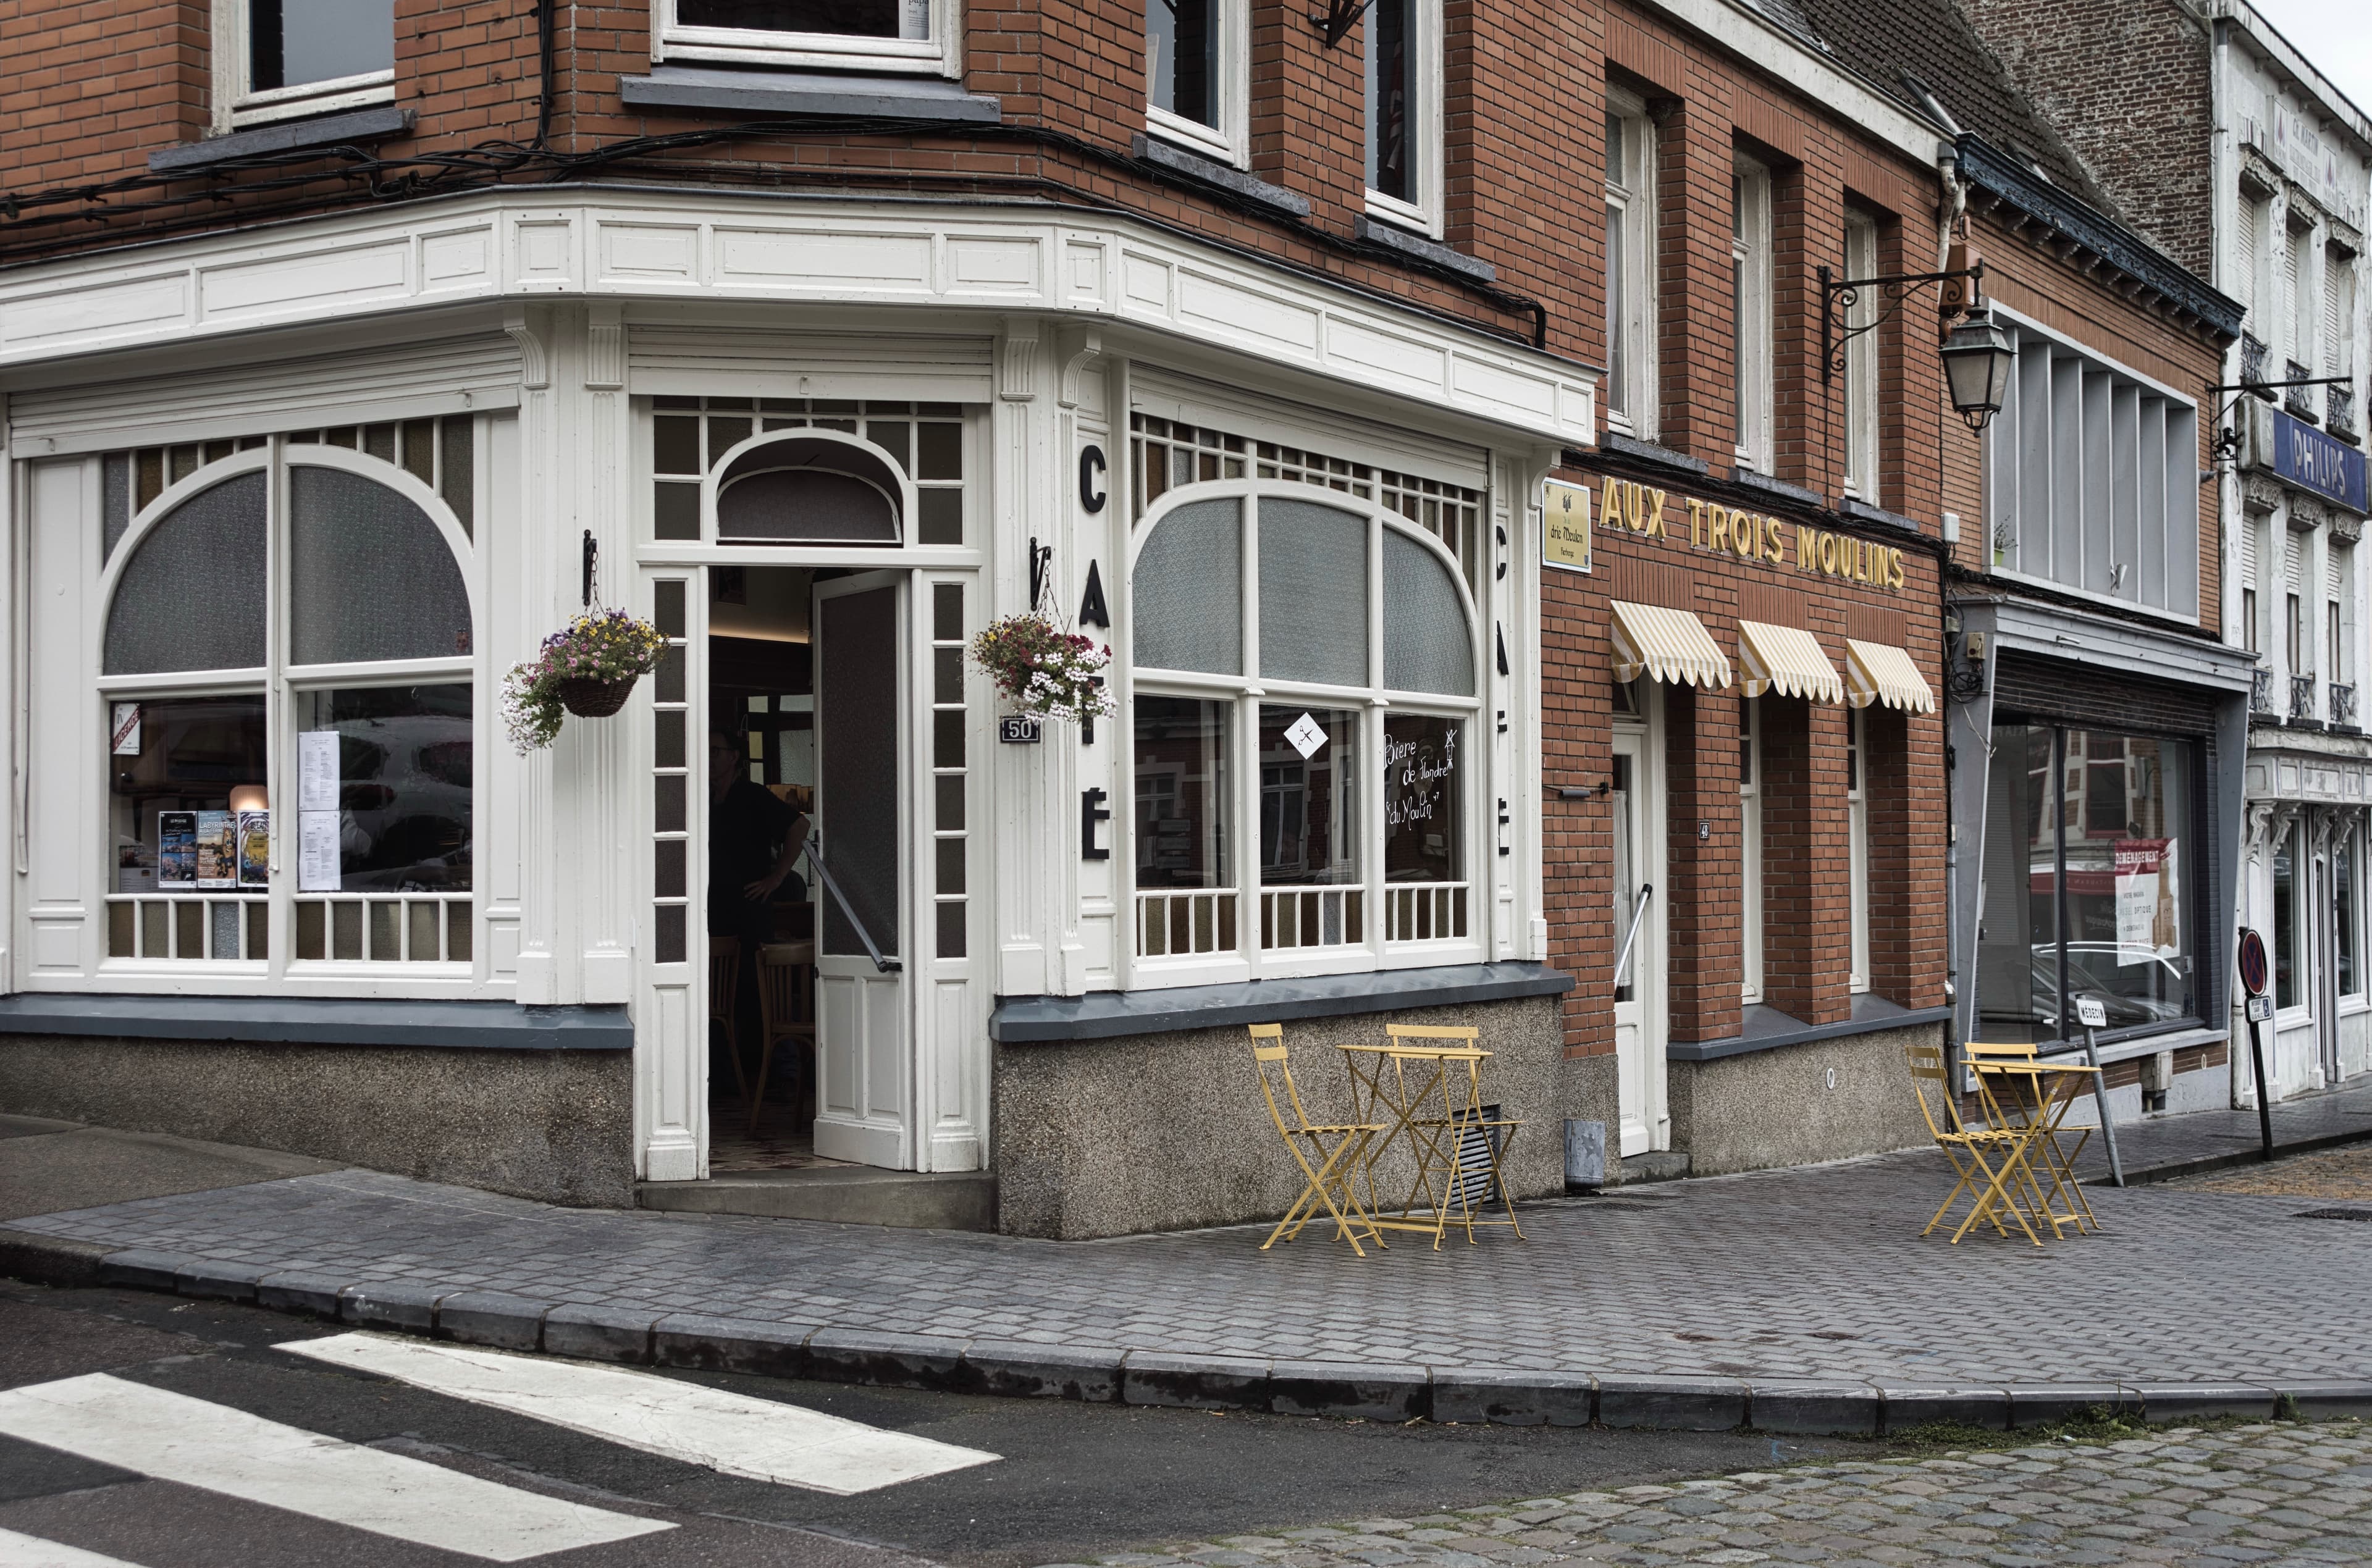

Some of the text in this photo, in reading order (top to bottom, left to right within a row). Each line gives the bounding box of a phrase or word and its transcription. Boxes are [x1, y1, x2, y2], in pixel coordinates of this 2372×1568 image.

[2294, 428, 2345, 497] PHILIPS
[1550, 524, 1583, 544] drie Meulen
[1599, 476, 1904, 593] AUX TROIS MOULINS
[115, 710, 139, 748] LICENCE
[1009, 721, 1032, 738] 50
[1403, 755, 1449, 786] de Flandre
[1701, 824, 1708, 837] 48
[2116, 850, 2158, 865] DÉMÉNAGEMENT
[2080, 1005, 2104, 1019] MÉDECIN
